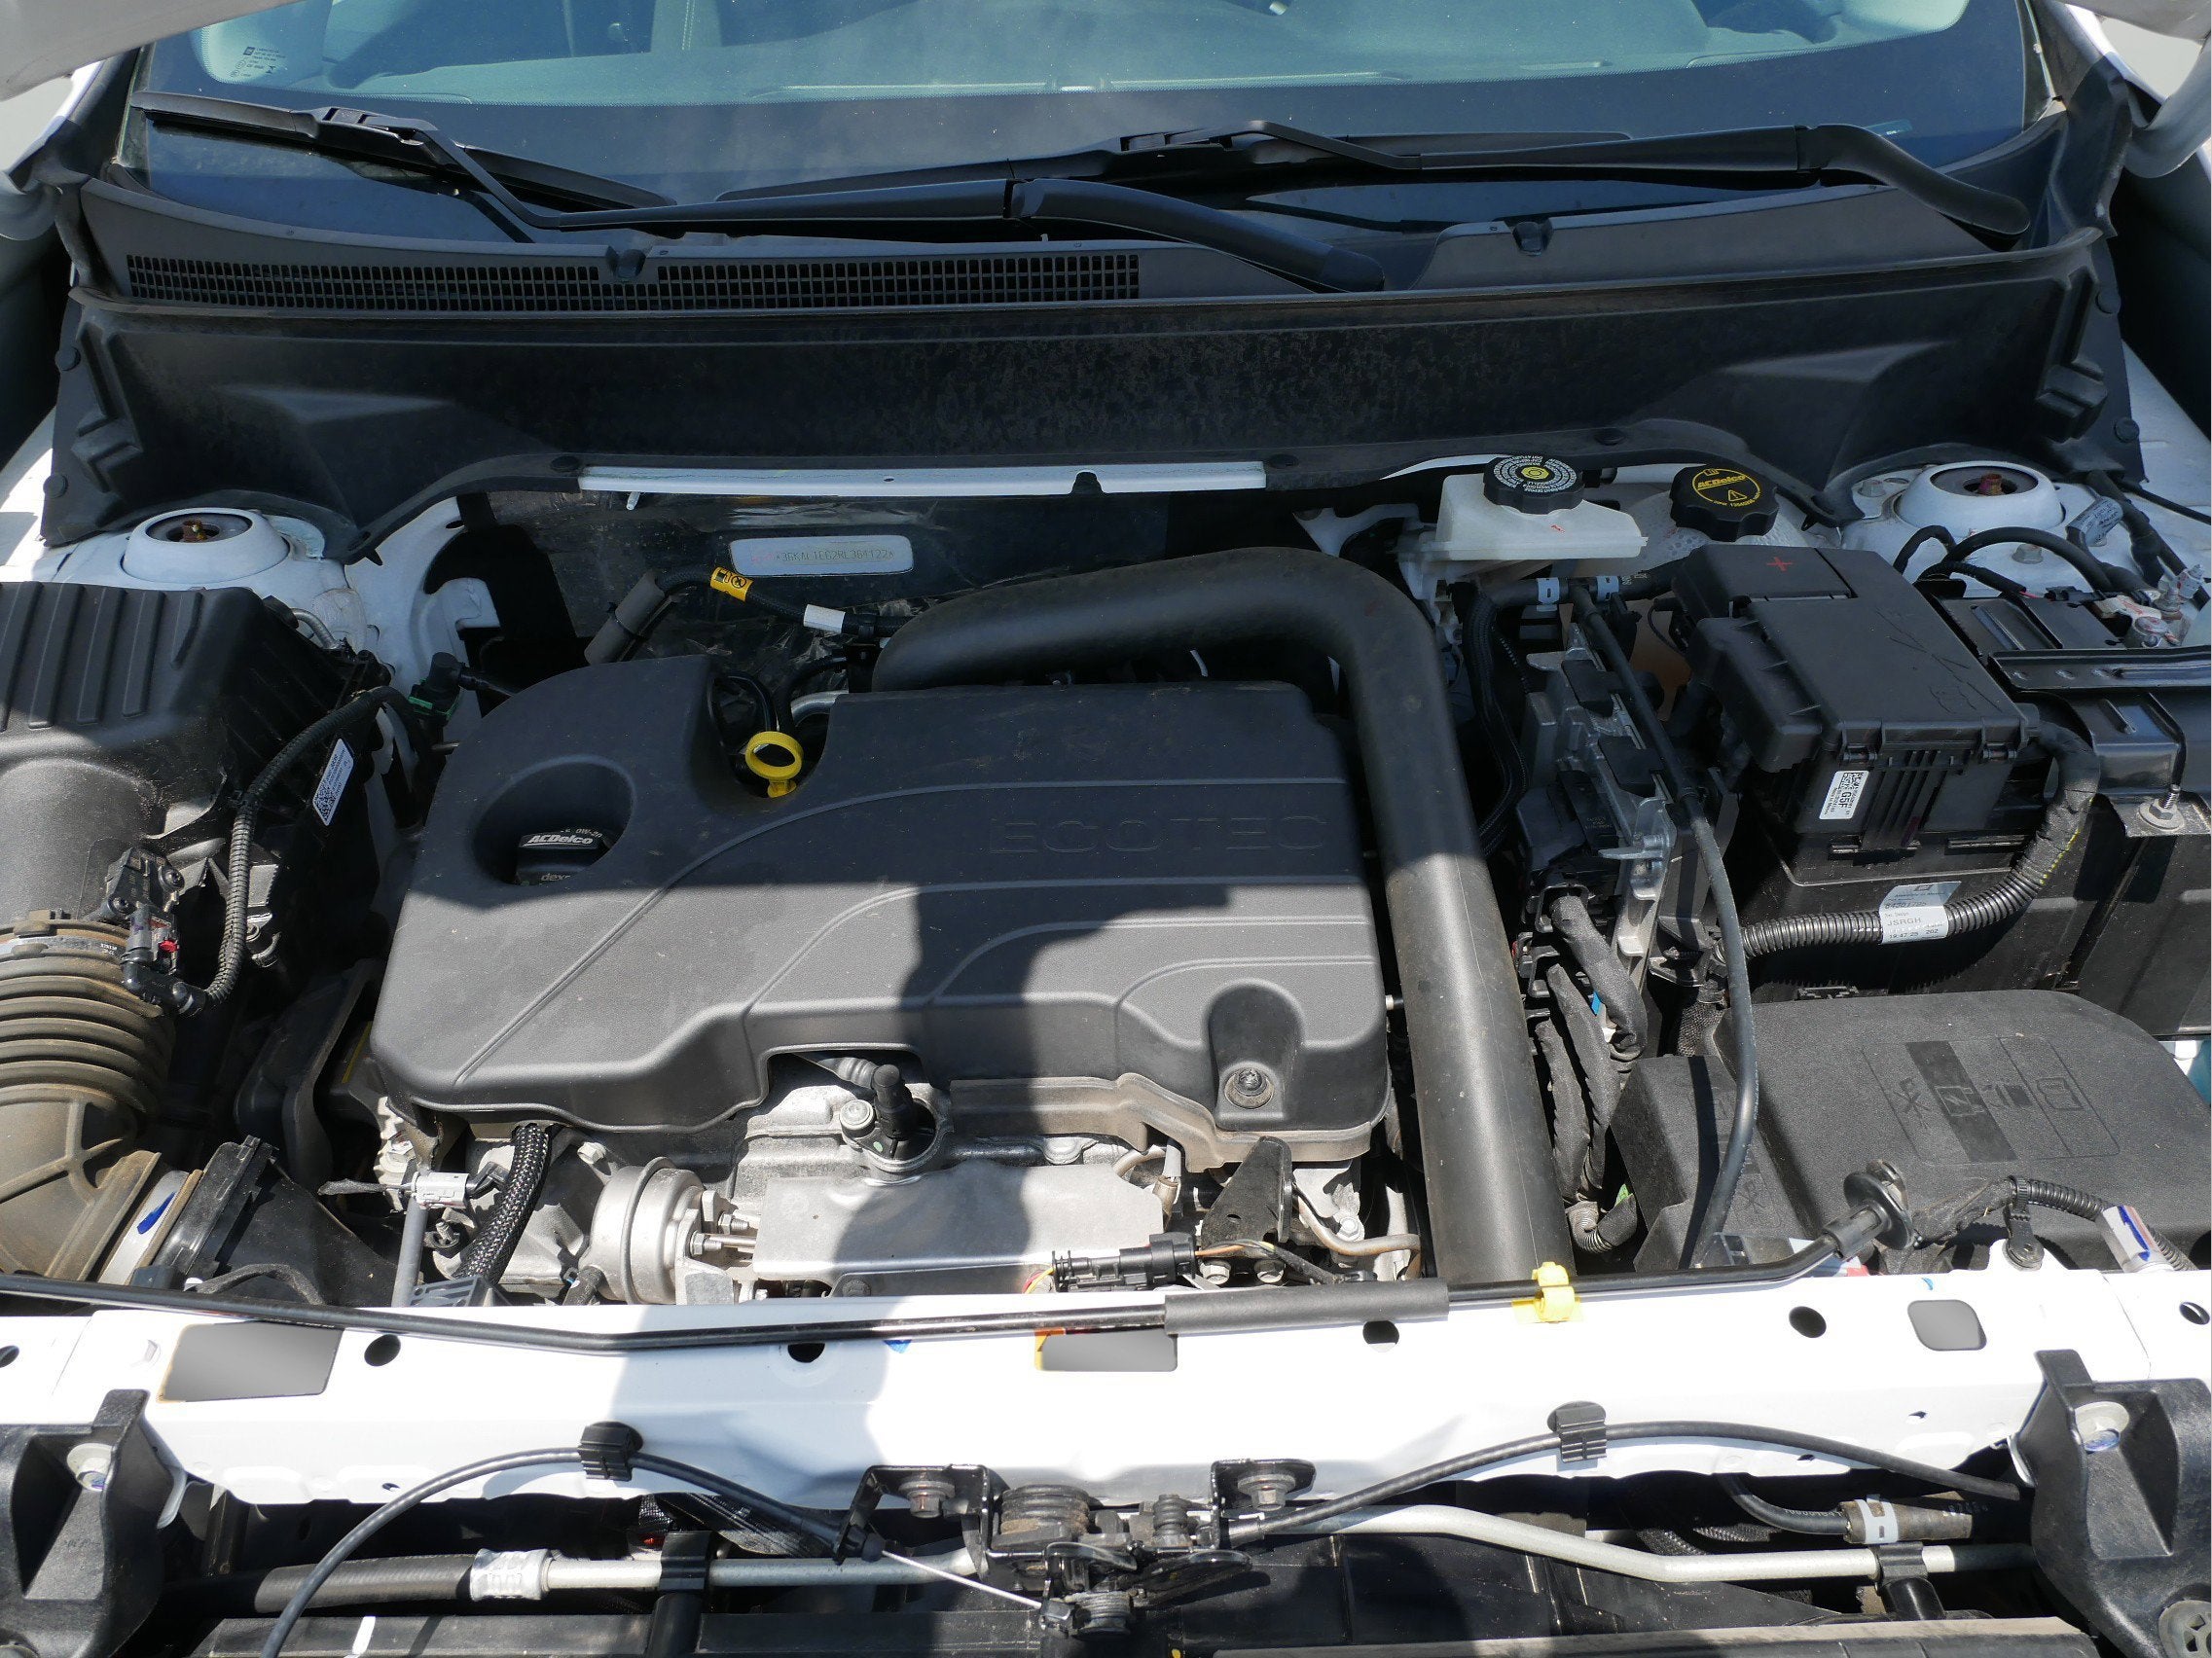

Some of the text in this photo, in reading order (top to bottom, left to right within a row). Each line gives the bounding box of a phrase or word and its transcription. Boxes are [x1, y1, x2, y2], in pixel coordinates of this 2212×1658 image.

[1697, 475, 1747, 488] ACDelco
[1838, 792, 1852, 808] G5F
[526, 834, 594, 845] ACDelco
[990, 815, 1327, 854] ECOTEC
